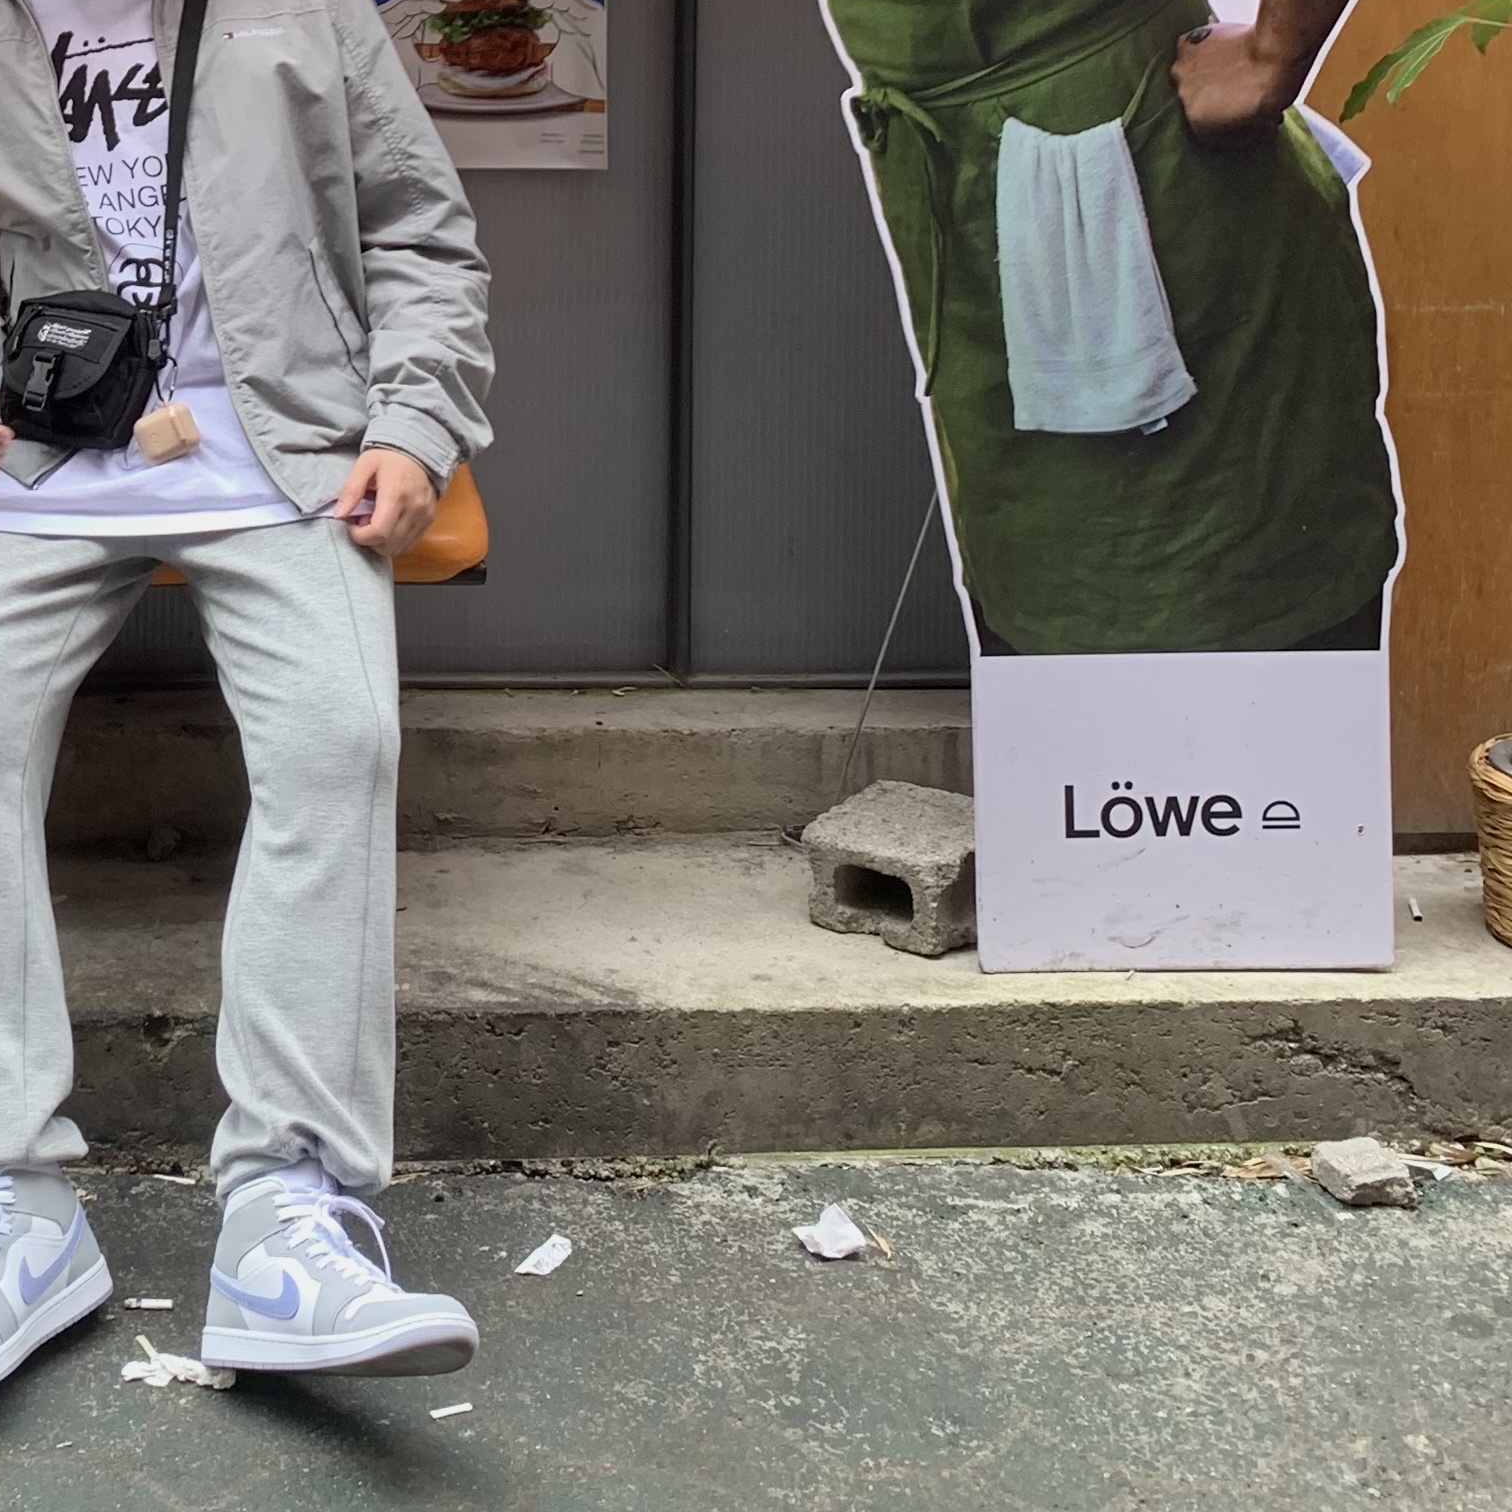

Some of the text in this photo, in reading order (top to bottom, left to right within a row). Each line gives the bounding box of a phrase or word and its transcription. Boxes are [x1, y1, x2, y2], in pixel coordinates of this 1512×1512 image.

[75, 155, 169, 187] EW YO
[91, 215, 164, 238] TOKY
[1064, 781, 1243, 838] Löwe
